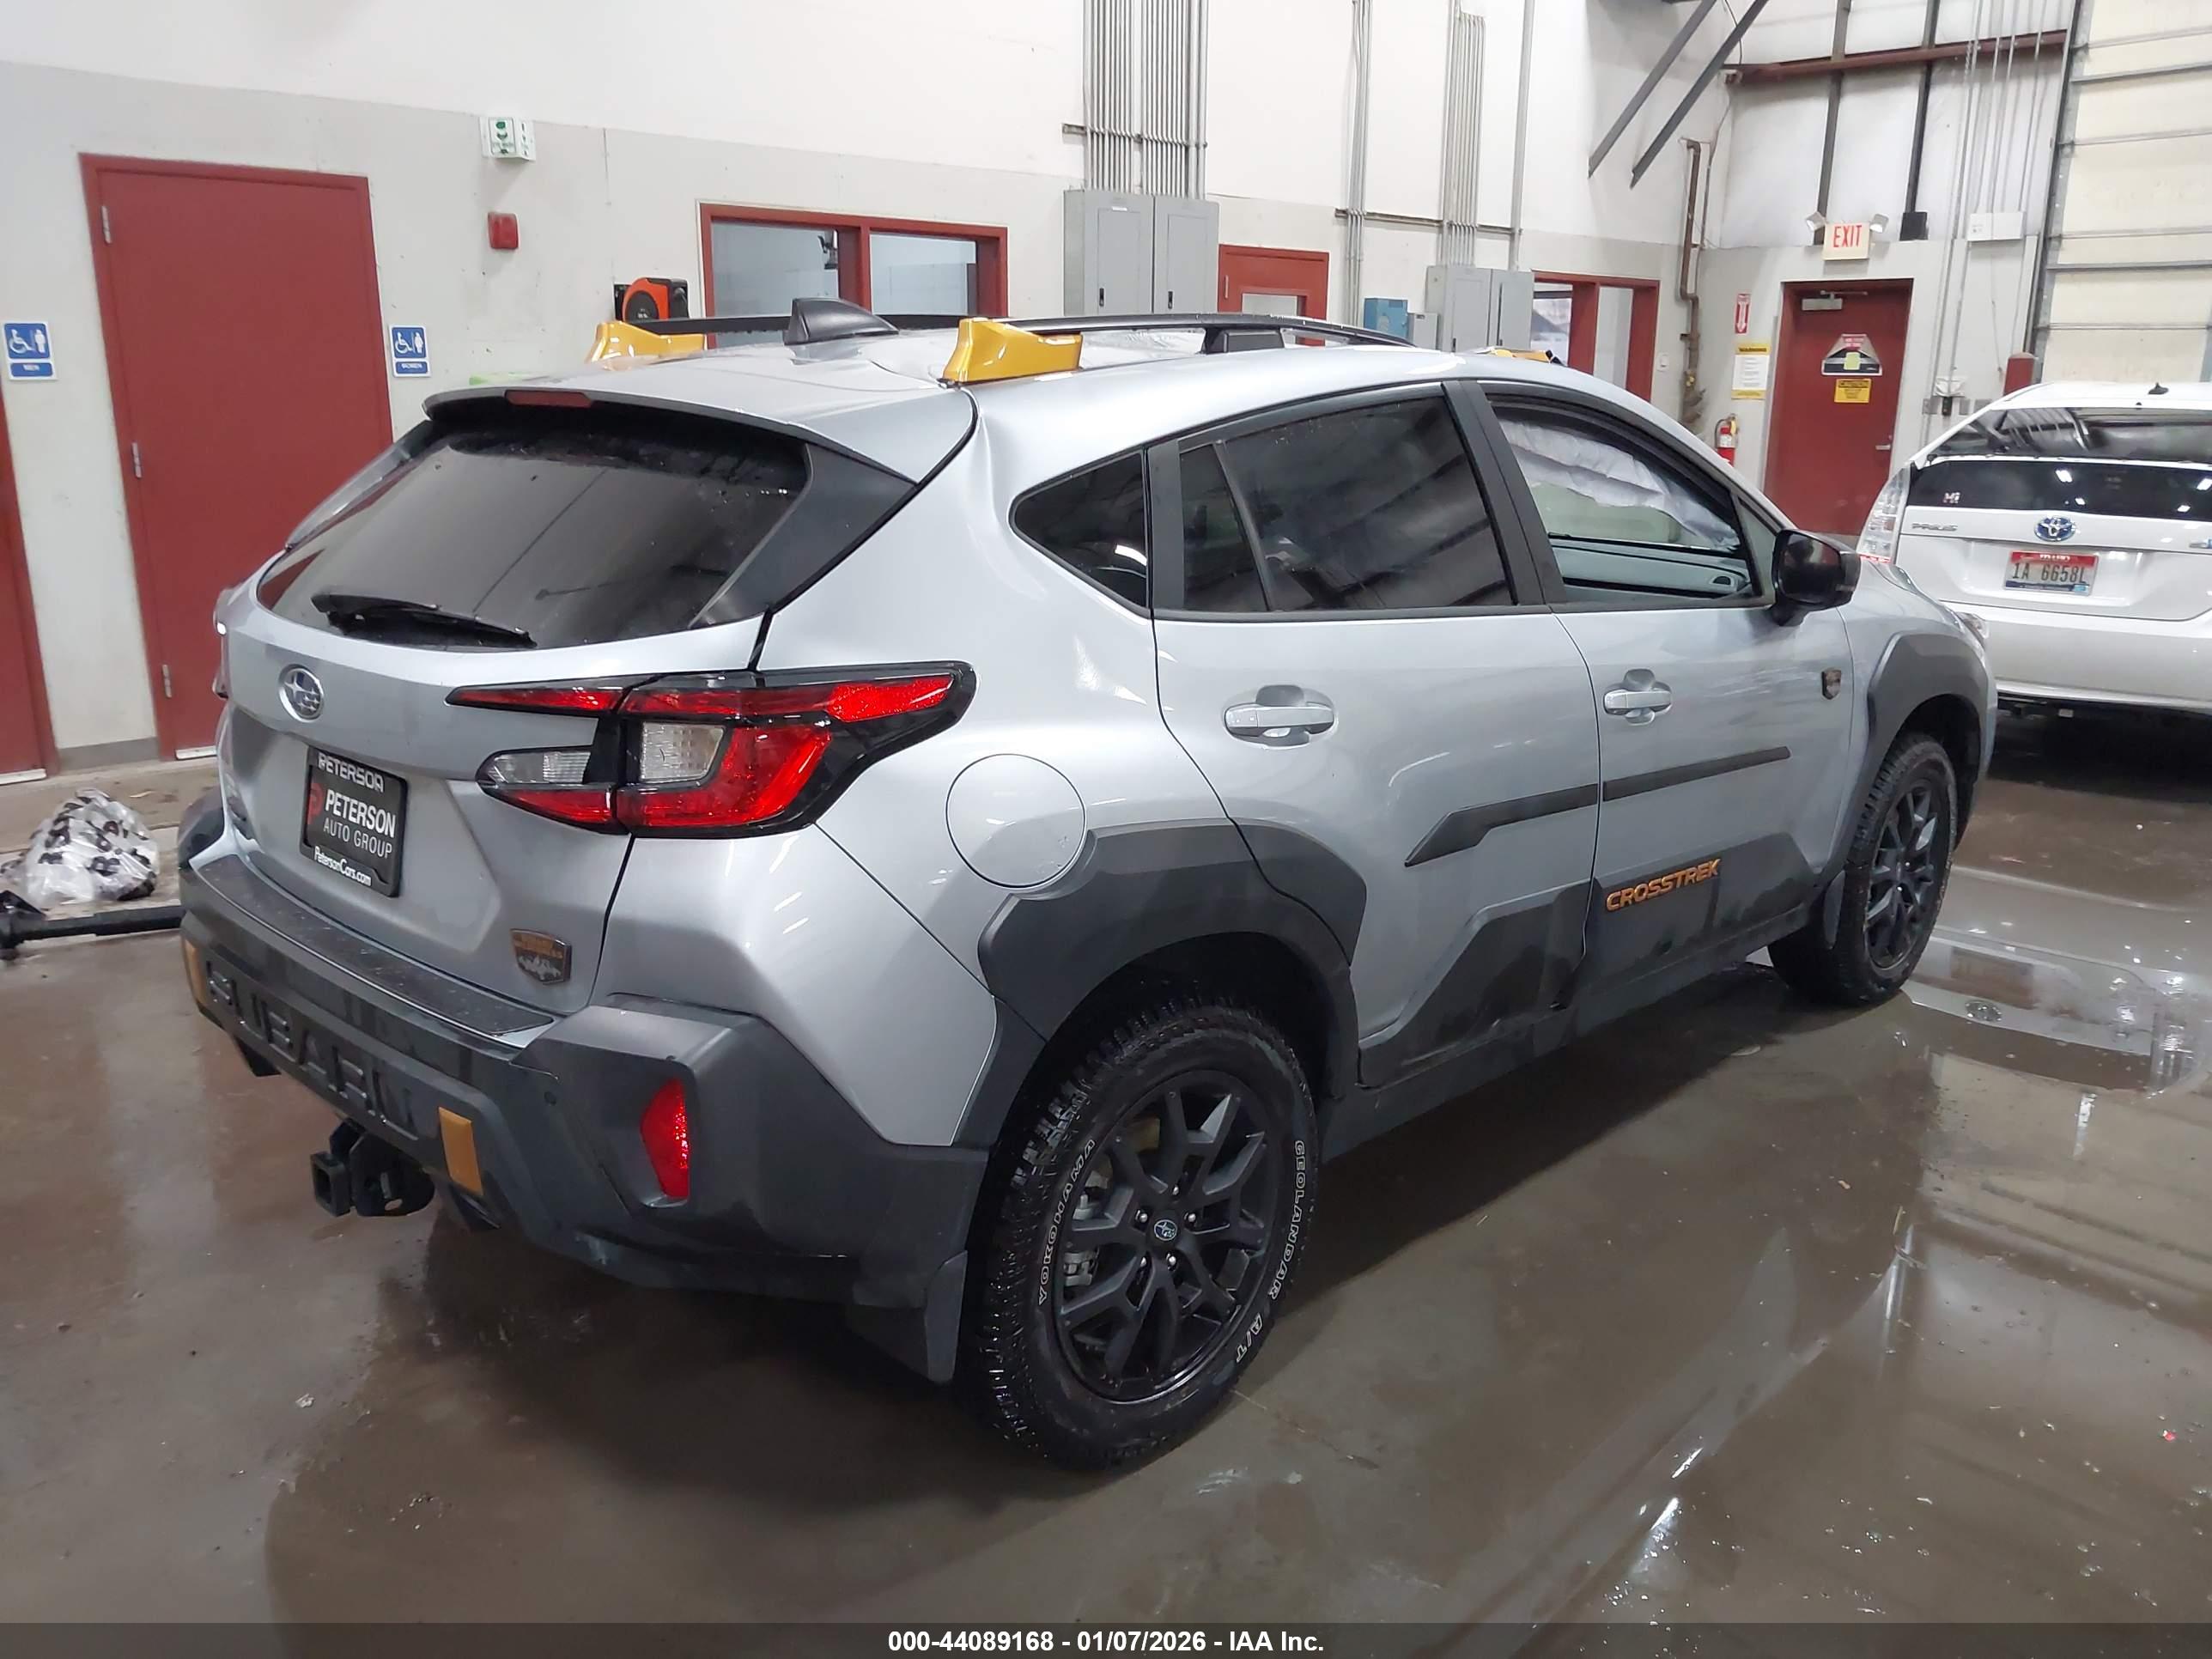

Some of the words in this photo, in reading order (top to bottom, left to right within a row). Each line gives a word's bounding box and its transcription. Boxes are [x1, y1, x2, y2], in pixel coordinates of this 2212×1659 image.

[1833, 225, 1862, 247] EXIT
[2012, 562, 2030, 580] 1A
[2041, 564, 2087, 583] 6658L
[325, 788, 396, 838] PETERSON
[323, 817, 350, 842] AUTO
[354, 830, 392, 860] GROUP
[314, 845, 372, 887] PetersonCars.com
[1607, 858, 1720, 911] CROSSTREK
[1039, 1139, 1096, 1305] YOKOHAMA
[1267, 1139, 1306, 1300] GEOLANDAR
[1236, 1312, 1263, 1364] A/T
